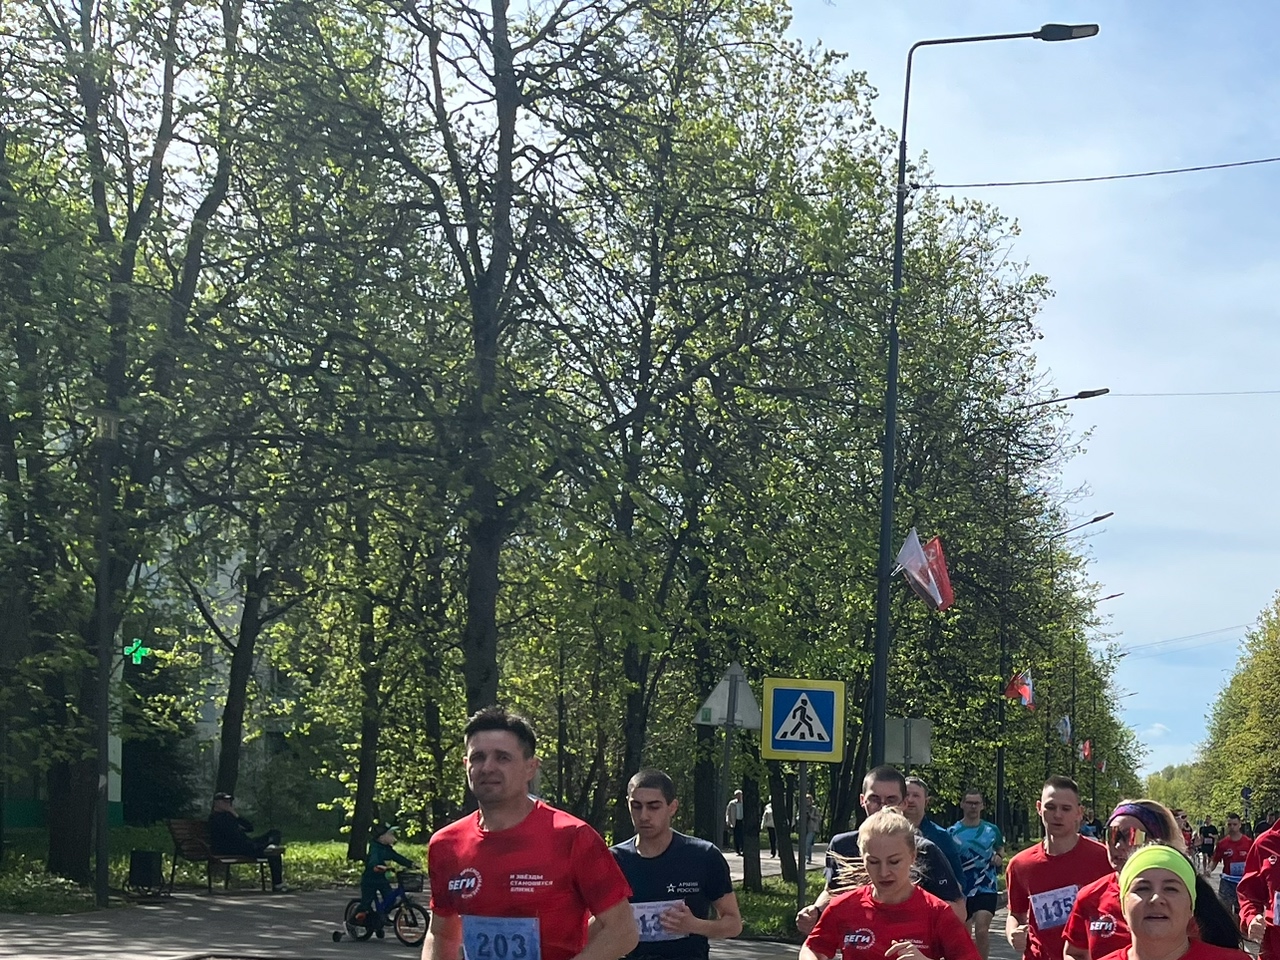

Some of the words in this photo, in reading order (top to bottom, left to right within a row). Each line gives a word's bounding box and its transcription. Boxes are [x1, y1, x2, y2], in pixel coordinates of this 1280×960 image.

[448, 877, 476, 891] БЕГИ
[1090, 921, 1113, 931] БЕГИ
[843, 934, 871, 943] БЕГИ
[476, 932, 527, 959] 203
